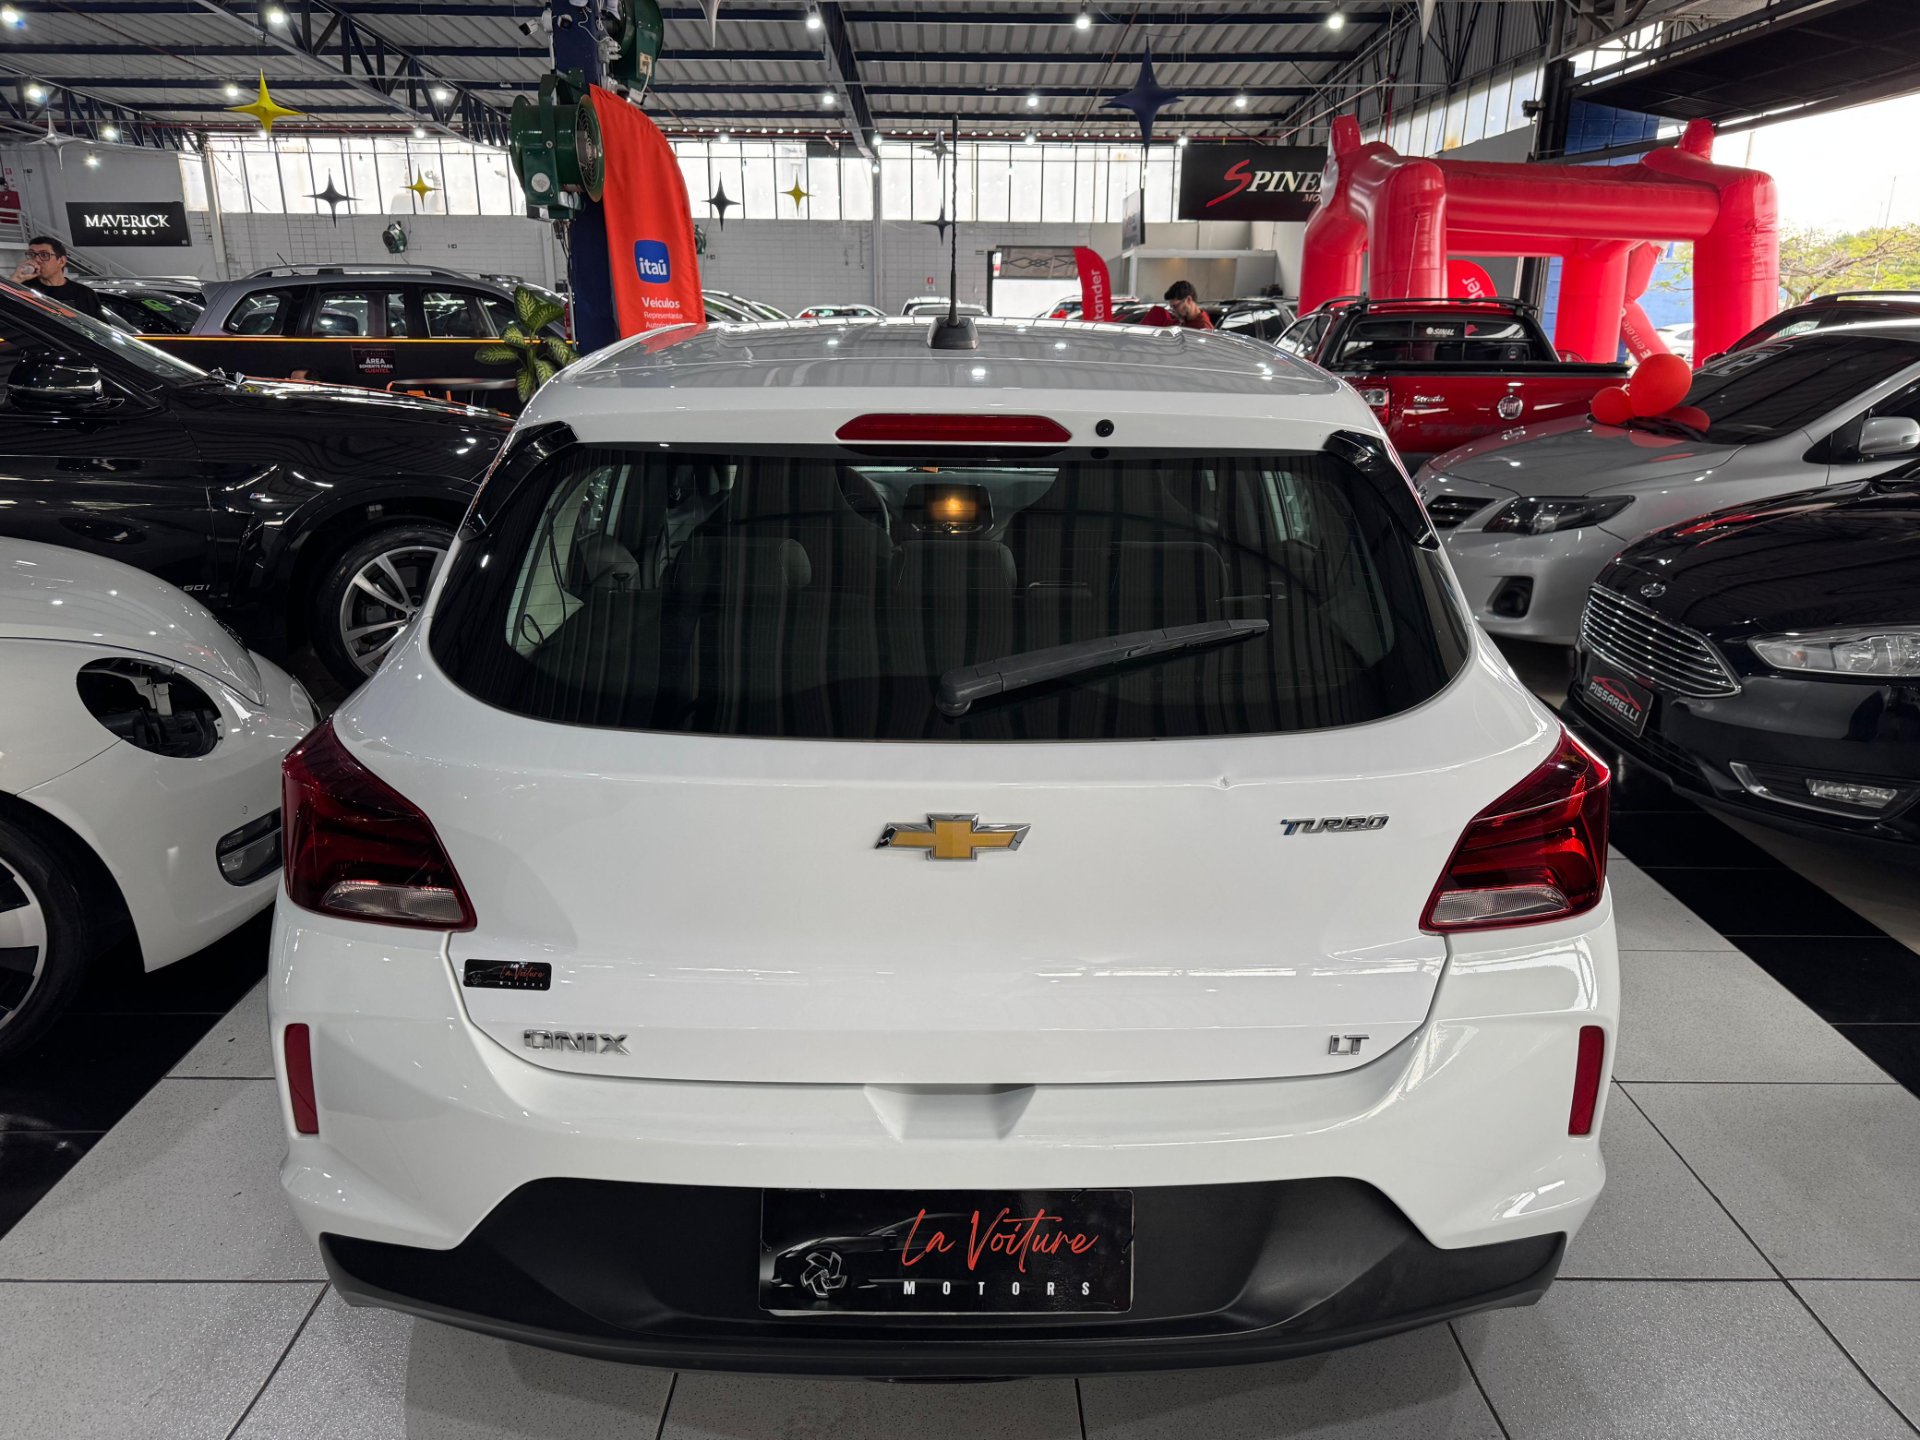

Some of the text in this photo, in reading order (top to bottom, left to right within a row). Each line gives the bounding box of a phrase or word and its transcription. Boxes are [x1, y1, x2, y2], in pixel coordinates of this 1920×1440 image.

[1206, 159, 1322, 208] SPINE
[84, 214, 171, 228] MAVERICK
[639, 257, 667, 276] itaú
[641, 297, 681, 309] Veículos
[1589, 682, 1641, 722] PISSARELLI
[1281, 814, 1390, 836] TURBO
[523, 1029, 632, 1056] ONIX
[1328, 1034, 1370, 1056] LT
[901, 1207, 1100, 1273] La Voiture
[903, 1280, 1091, 1296] MOTORS
